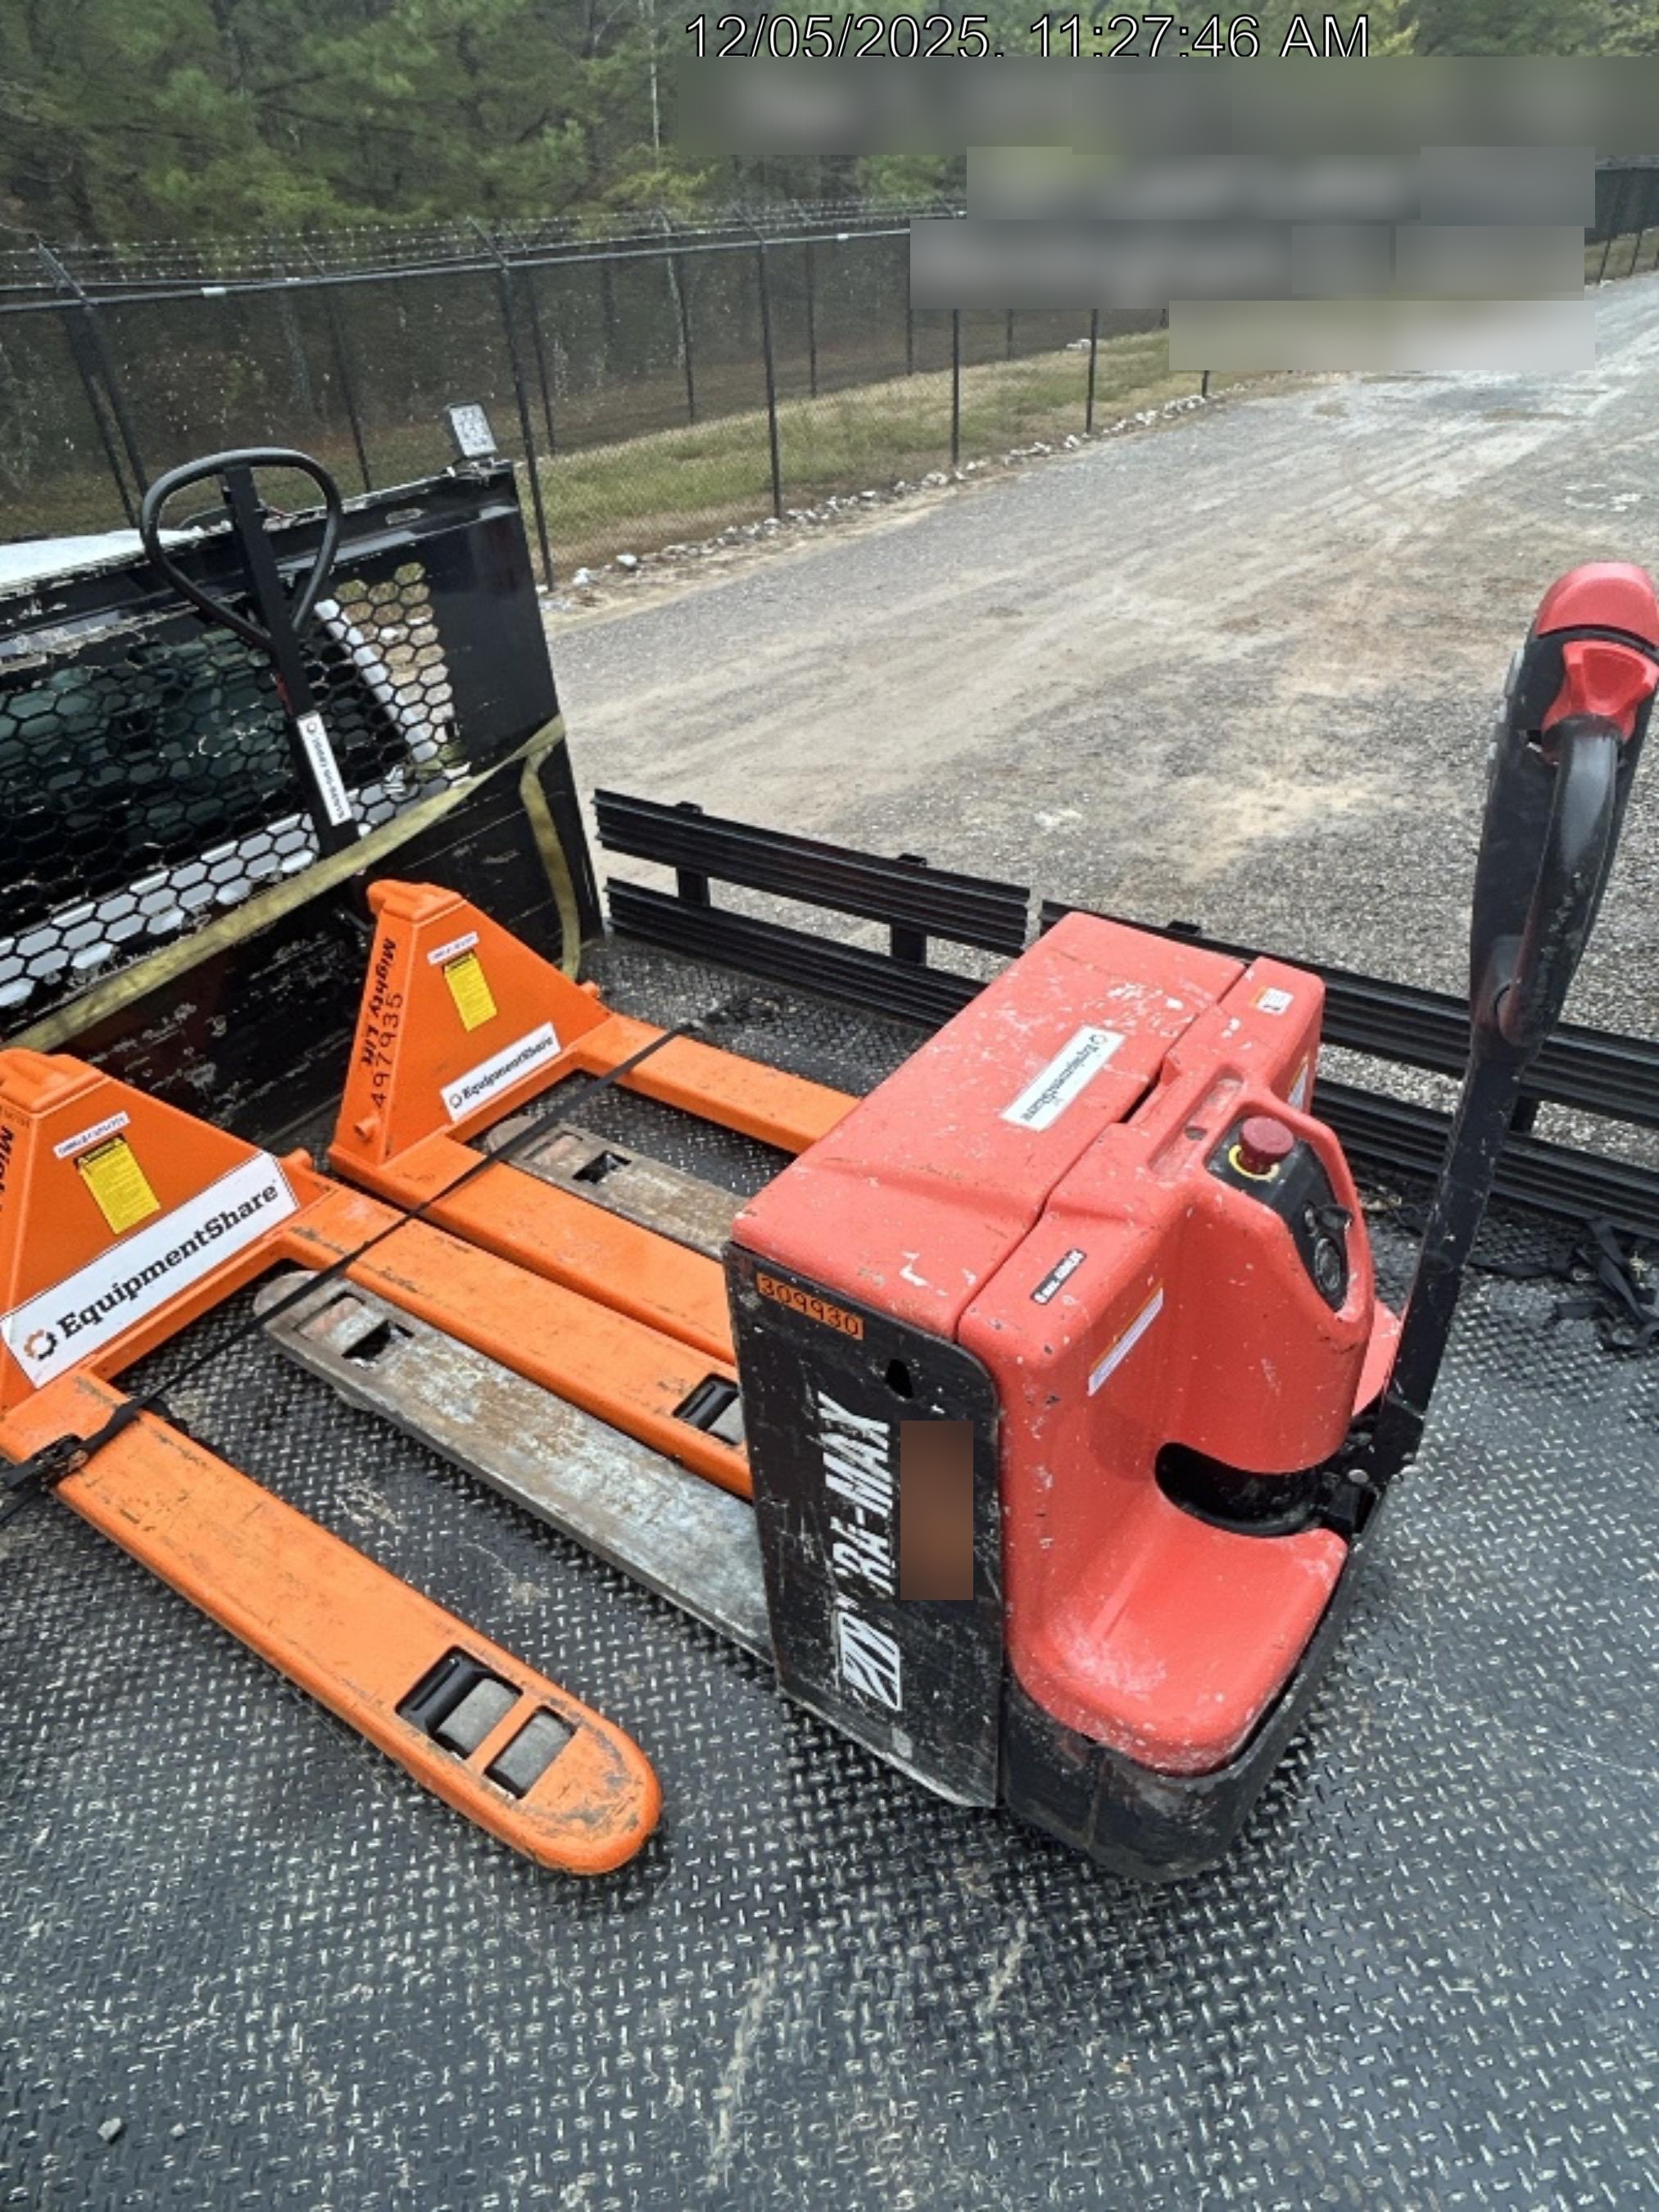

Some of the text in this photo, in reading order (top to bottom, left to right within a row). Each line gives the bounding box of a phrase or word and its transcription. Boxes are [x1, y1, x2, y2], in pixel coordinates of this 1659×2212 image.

[360, 938, 397, 1065] Mighty Lift
[369, 993, 403, 1108] 497935
[463, 1036, 554, 1099] EquipmentShare
[57, 1185, 279, 1339] EquipmentShare
[761, 1276, 859, 1335] 309930
